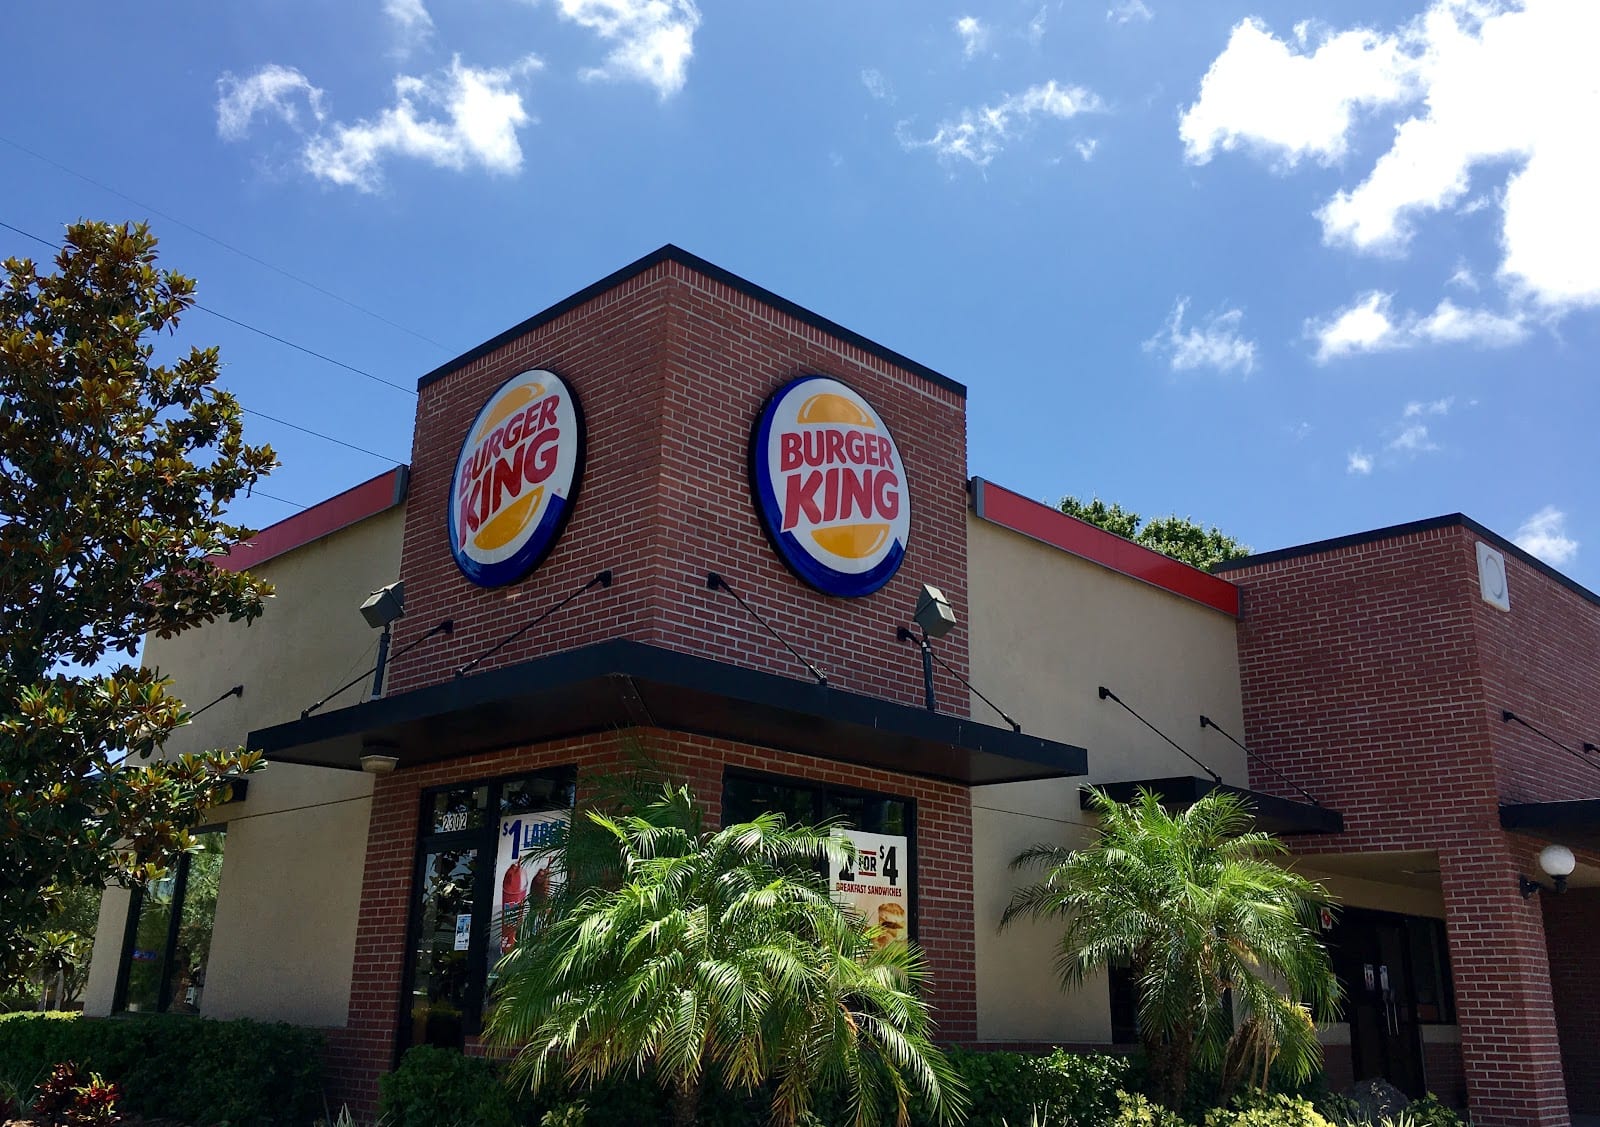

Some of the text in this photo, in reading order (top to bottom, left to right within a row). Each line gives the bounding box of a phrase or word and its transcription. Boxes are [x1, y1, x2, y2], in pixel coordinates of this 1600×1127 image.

[459, 394, 560, 499] BURGER
[780, 429, 894, 472] BURGER
[459, 427, 560, 551] KING
[783, 467, 899, 530] KING
[502, 819, 522, 860] $1
[859, 855, 877, 872] FOR
[880, 845, 898, 886] $4
[836, 883, 902, 897] BREAKFAST SANDWICHES
